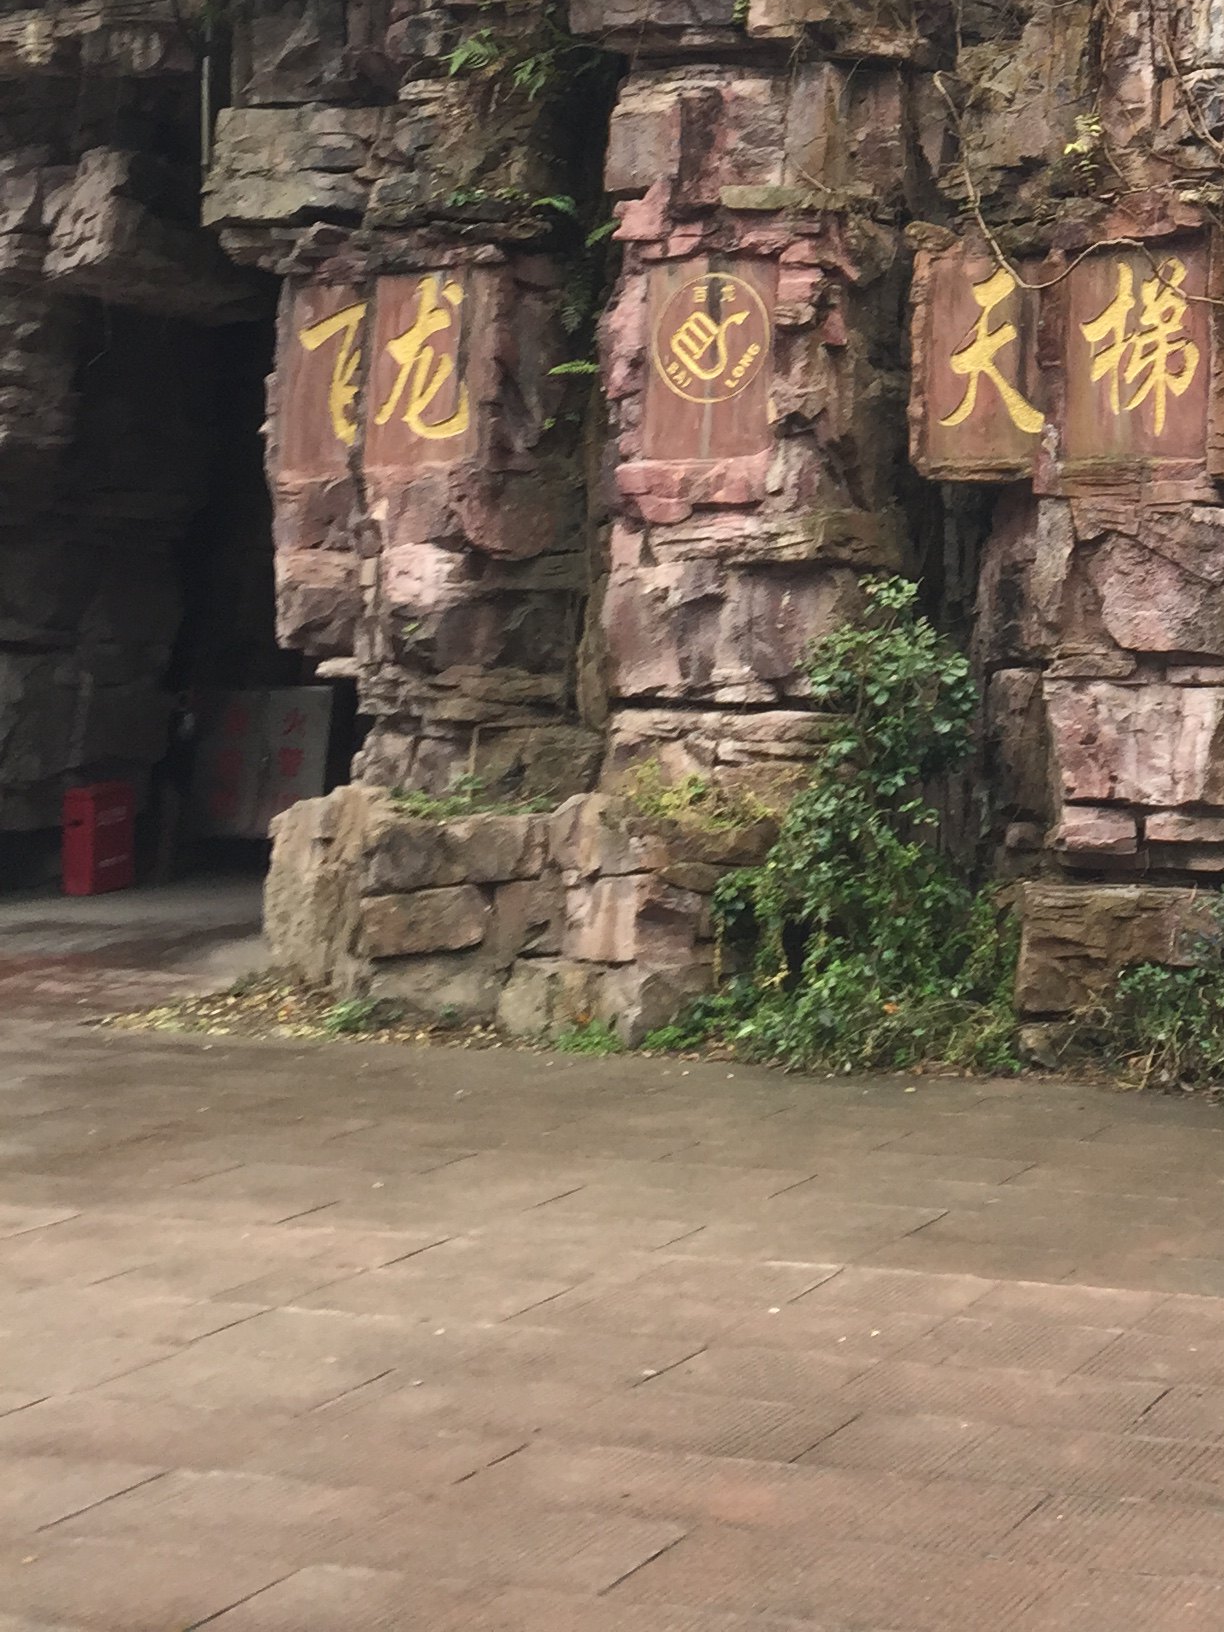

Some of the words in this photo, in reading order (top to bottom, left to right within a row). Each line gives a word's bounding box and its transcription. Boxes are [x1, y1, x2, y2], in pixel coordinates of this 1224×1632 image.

[723, 341, 761, 388] LONG
[938, 257, 1201, 438] 天梯
[665, 361, 694, 388] BAI
